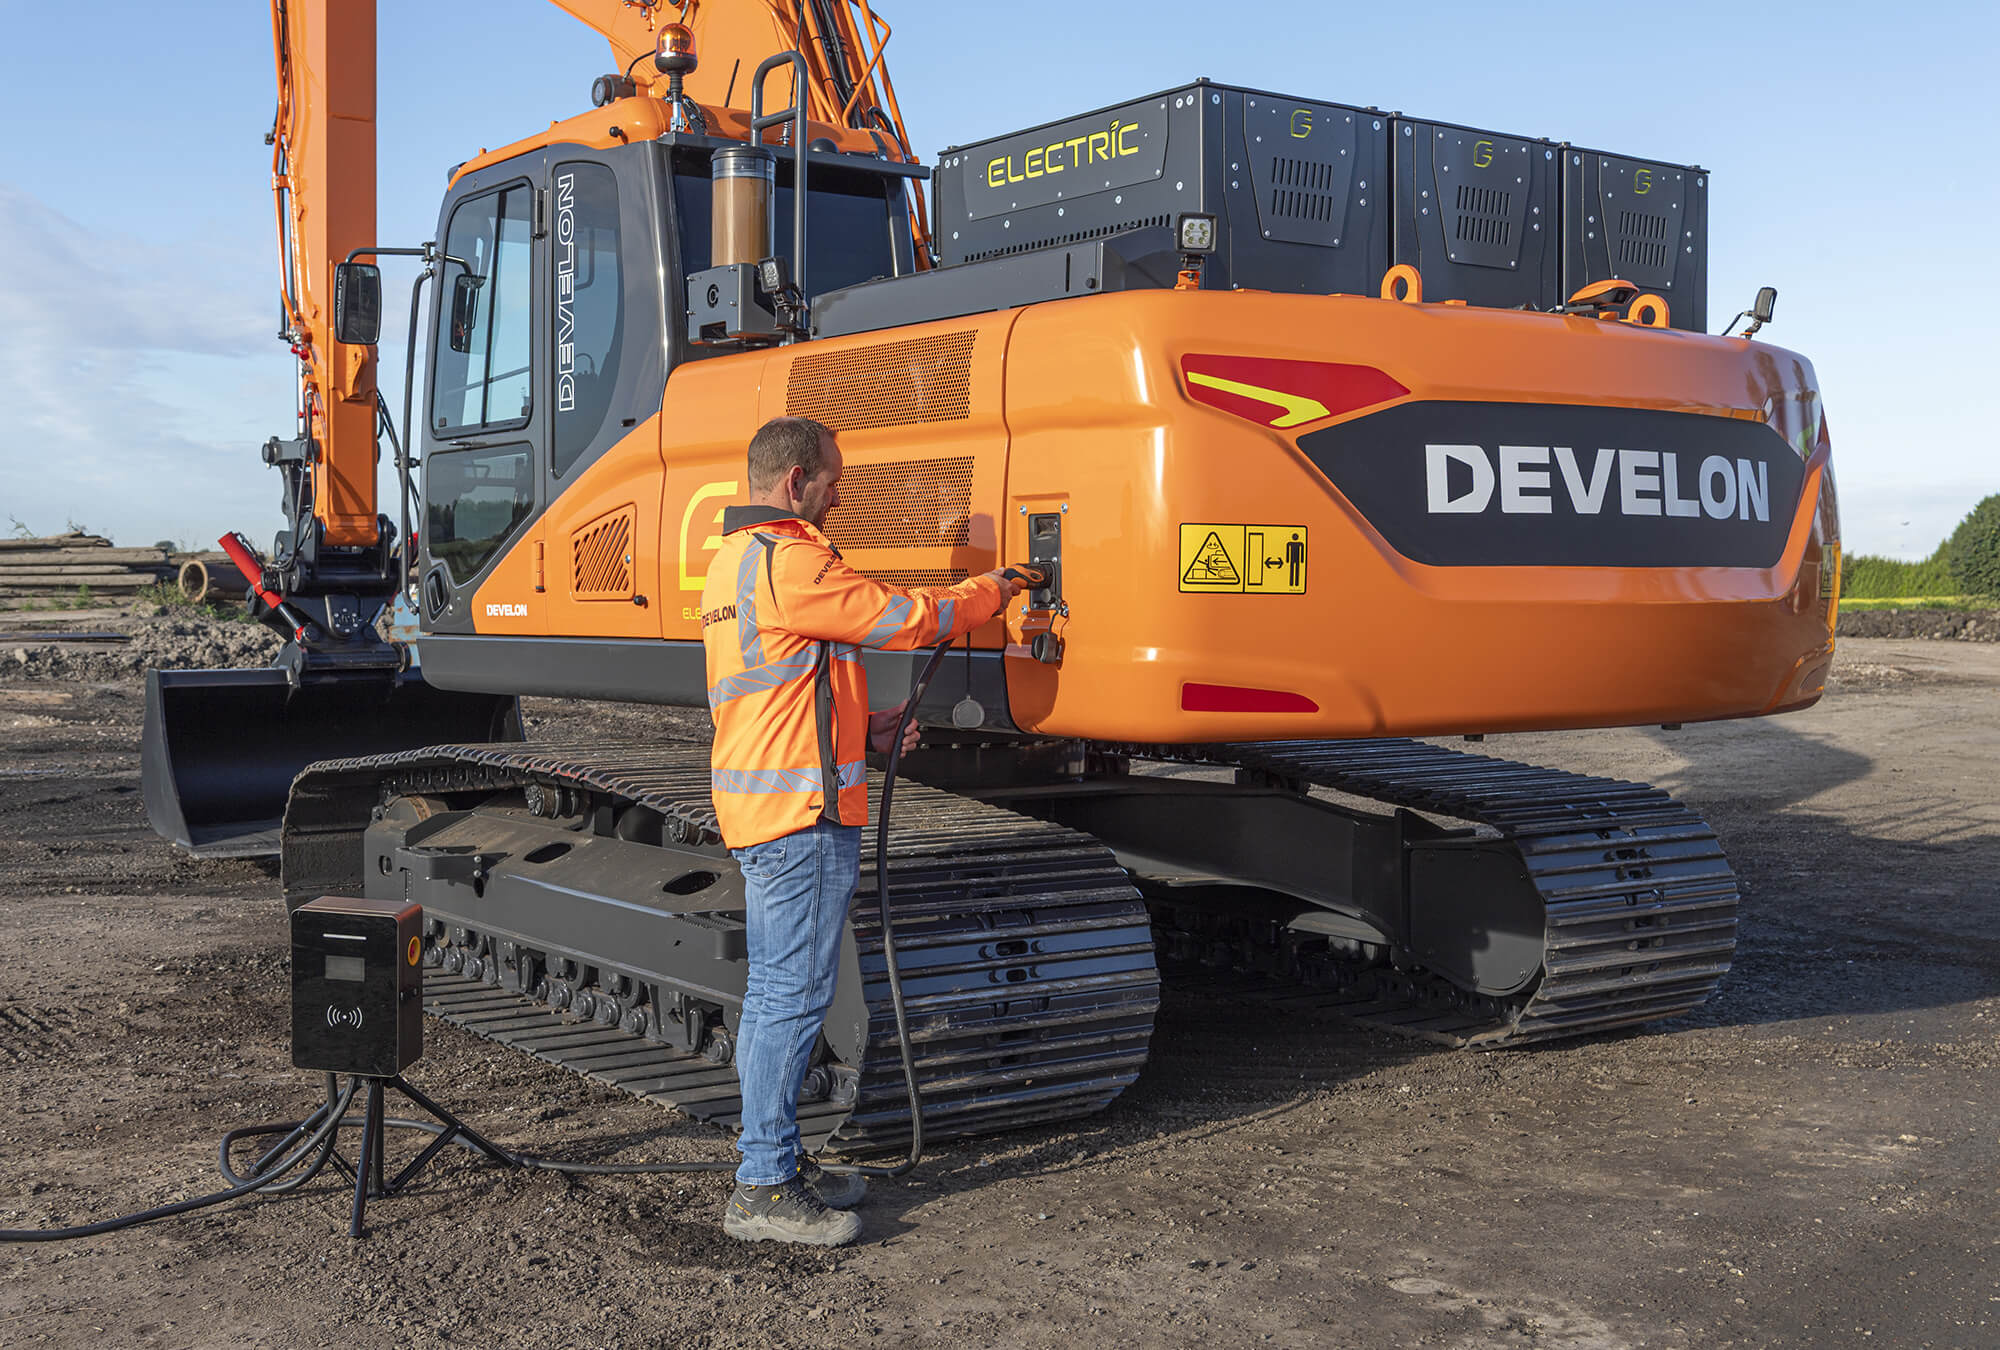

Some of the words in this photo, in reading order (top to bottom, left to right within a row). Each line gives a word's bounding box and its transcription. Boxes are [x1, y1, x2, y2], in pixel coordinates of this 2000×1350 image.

[987, 119, 1139, 188] ELECTRIC
[557, 173, 575, 412] DEVELON
[1424, 444, 1770, 522] DEVELON
[814, 554, 837, 585] DEVEL
[486, 604, 528, 616] DEVELON
